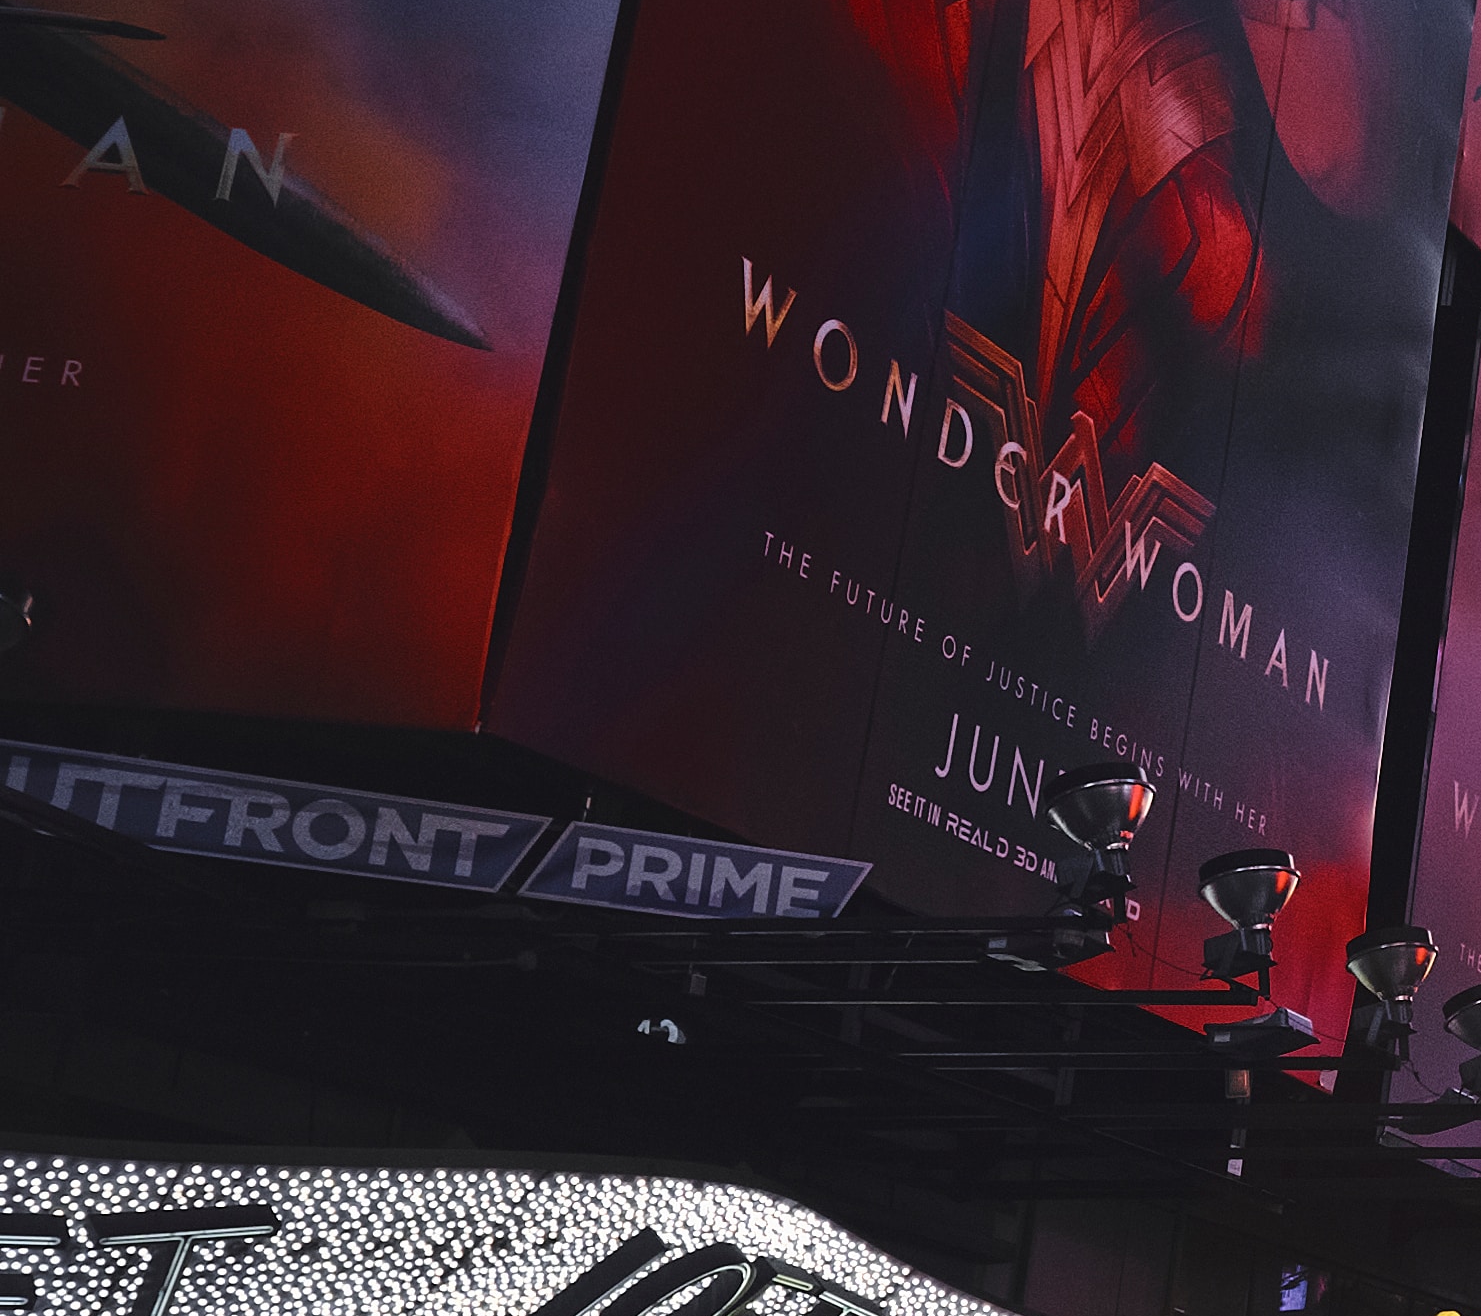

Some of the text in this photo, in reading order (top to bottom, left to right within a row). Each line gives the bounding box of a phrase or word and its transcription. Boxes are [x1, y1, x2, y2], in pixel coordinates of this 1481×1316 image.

[0, 107, 300, 209] AN
[742, 255, 1332, 711] WONDER WOMAN
[762, 531, 1269, 838] THE FUTURE OF JUSTICE BEGINS WITH HER
[888, 783, 913, 813] SEE
[913, 794, 926, 819] IT
[927, 801, 942, 827] IN
[934, 713, 1068, 820] JUN
[570, 835, 832, 920] PRIME
